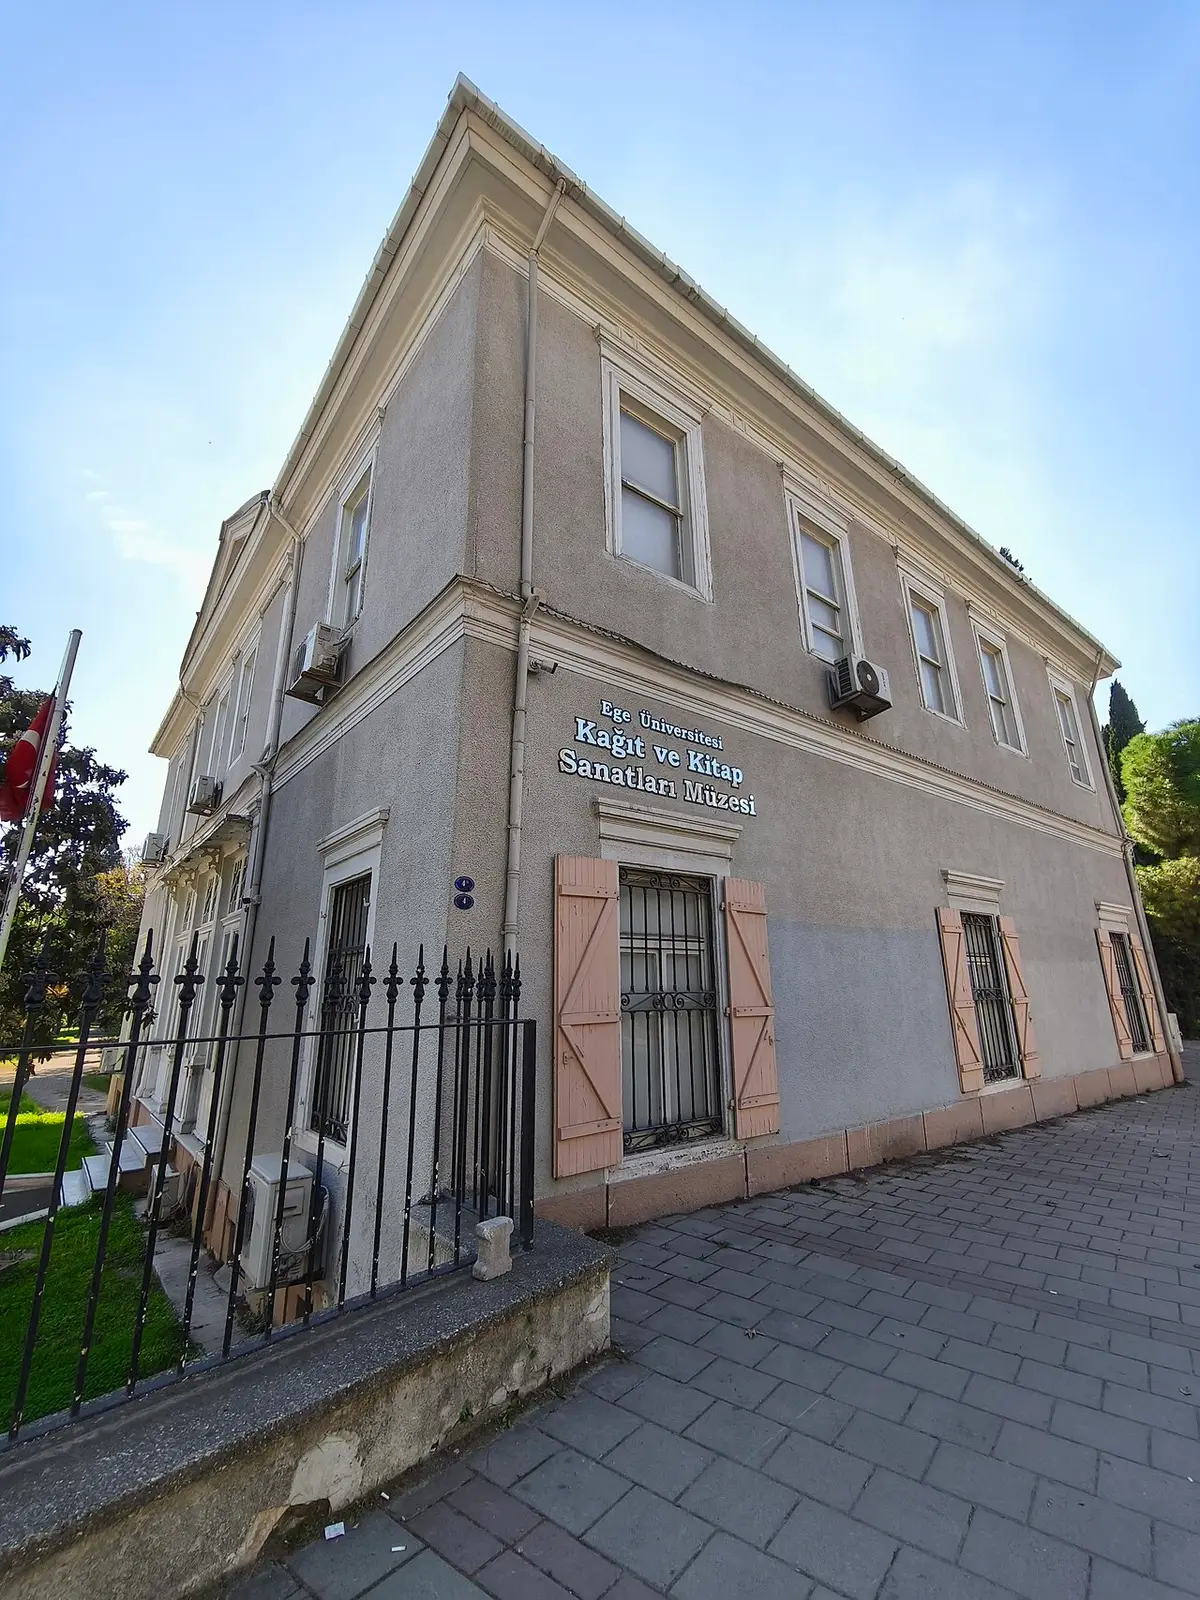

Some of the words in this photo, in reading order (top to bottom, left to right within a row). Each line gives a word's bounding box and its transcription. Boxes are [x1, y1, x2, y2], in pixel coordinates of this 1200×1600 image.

[575, 717, 645, 758] Kağıt
[653, 745, 680, 767] ve
[687, 750, 744, 788] Kitap
[601, 700, 631, 723] Ege
[639, 708, 723, 750] Üniversitesi
[559, 748, 677, 798] Sanatları
[683, 780, 757, 816] Müzesi
